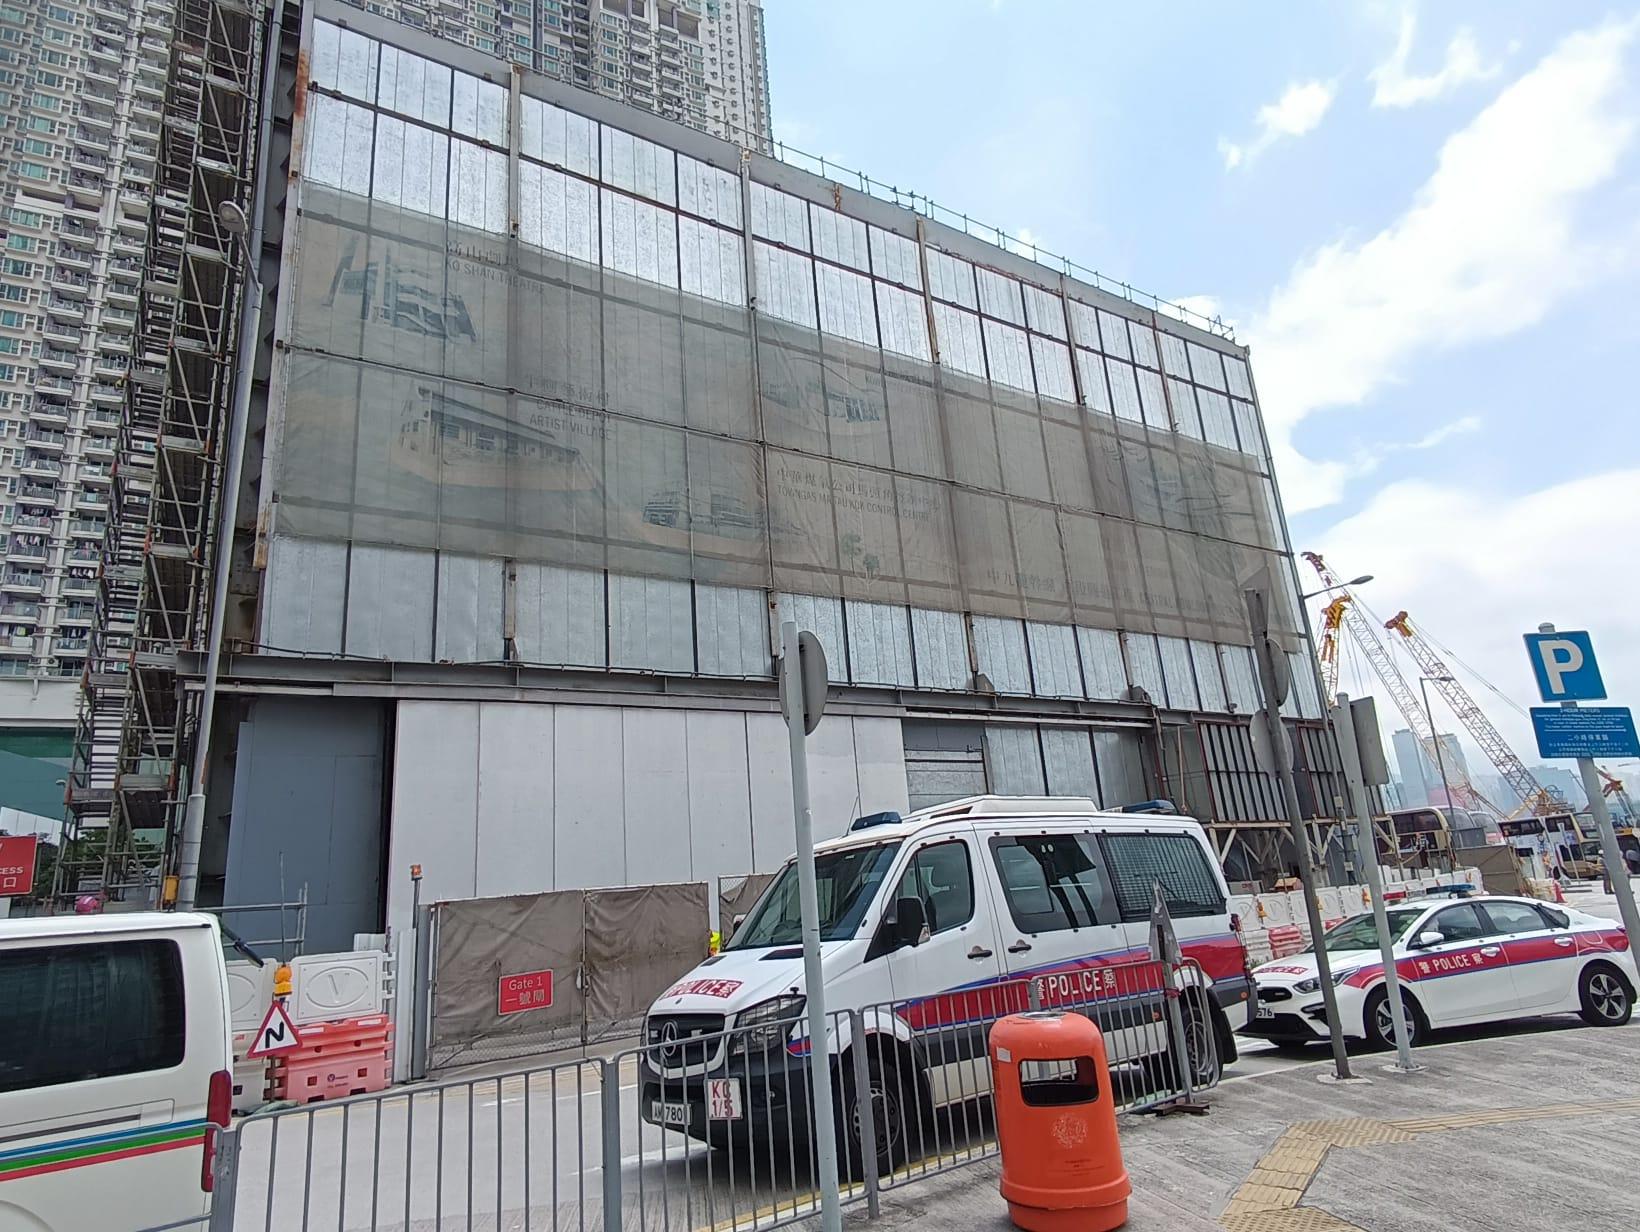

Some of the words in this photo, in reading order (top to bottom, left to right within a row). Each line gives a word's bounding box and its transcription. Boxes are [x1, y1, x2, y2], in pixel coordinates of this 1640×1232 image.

[464, 262, 495, 281] SHAN
[530, 413, 566, 432] ARTIST
[866, 501, 902, 518] CONTRO
[1537, 639, 1584, 695] P
[1432, 954, 1471, 971] POLICE
[508, 977, 534, 991] Gate
[537, 975, 543, 987] 1
[1048, 970, 1102, 999] POLICE
